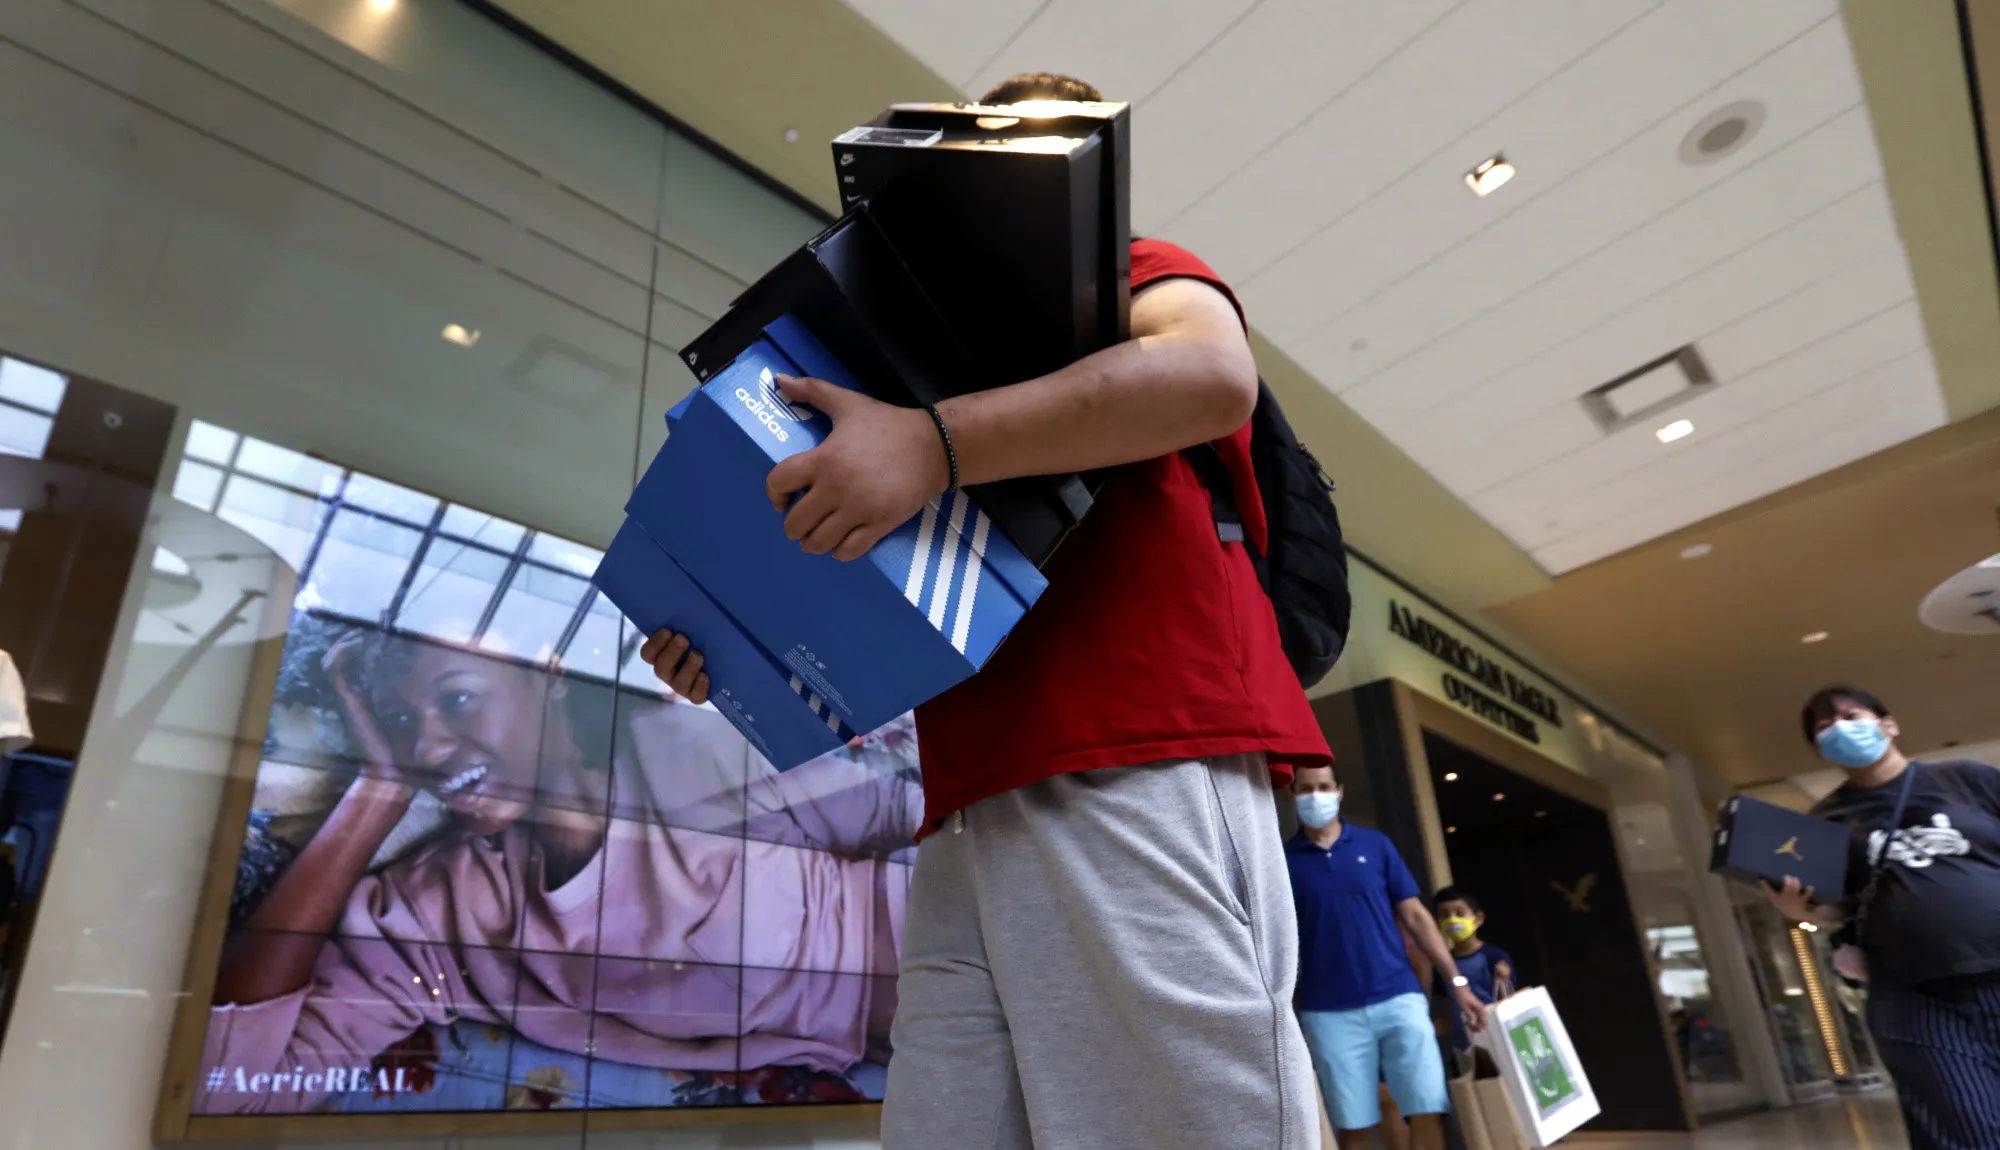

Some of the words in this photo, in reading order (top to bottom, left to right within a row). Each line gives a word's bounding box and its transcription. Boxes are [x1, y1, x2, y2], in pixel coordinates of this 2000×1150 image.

[735, 387, 789, 443] adidas
[1388, 598, 1506, 696] AMERICAN
[1504, 670, 1564, 729] EAGLE
